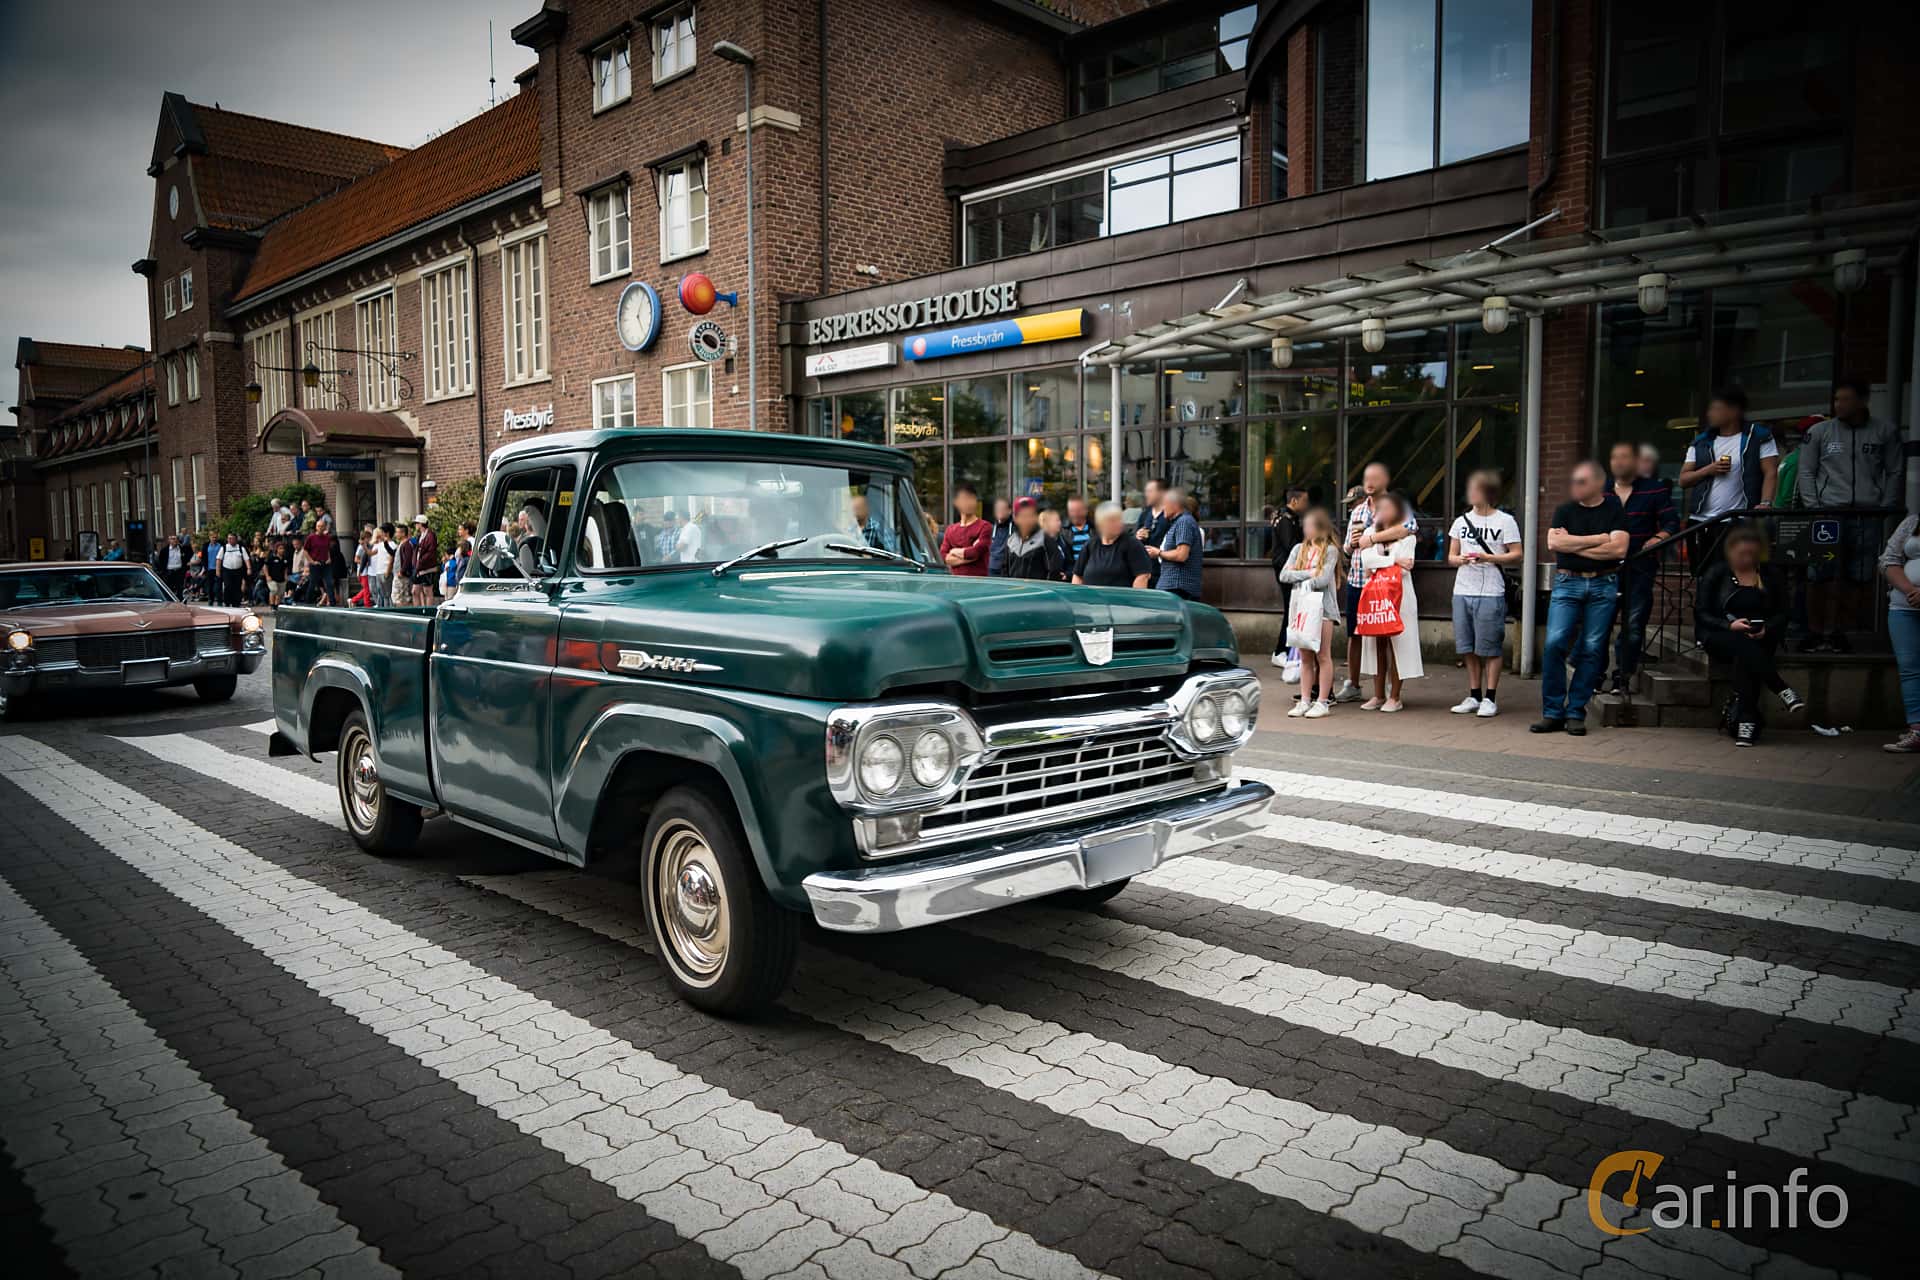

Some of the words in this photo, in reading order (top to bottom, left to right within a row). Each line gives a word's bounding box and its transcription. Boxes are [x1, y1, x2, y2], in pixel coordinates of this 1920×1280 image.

[808, 301, 918, 346] ESPRESSO
[916, 281, 1018, 327] HOUSE
[951, 329, 1005, 349] Pressbyrån
[1369, 598, 1396, 613] TEAM
